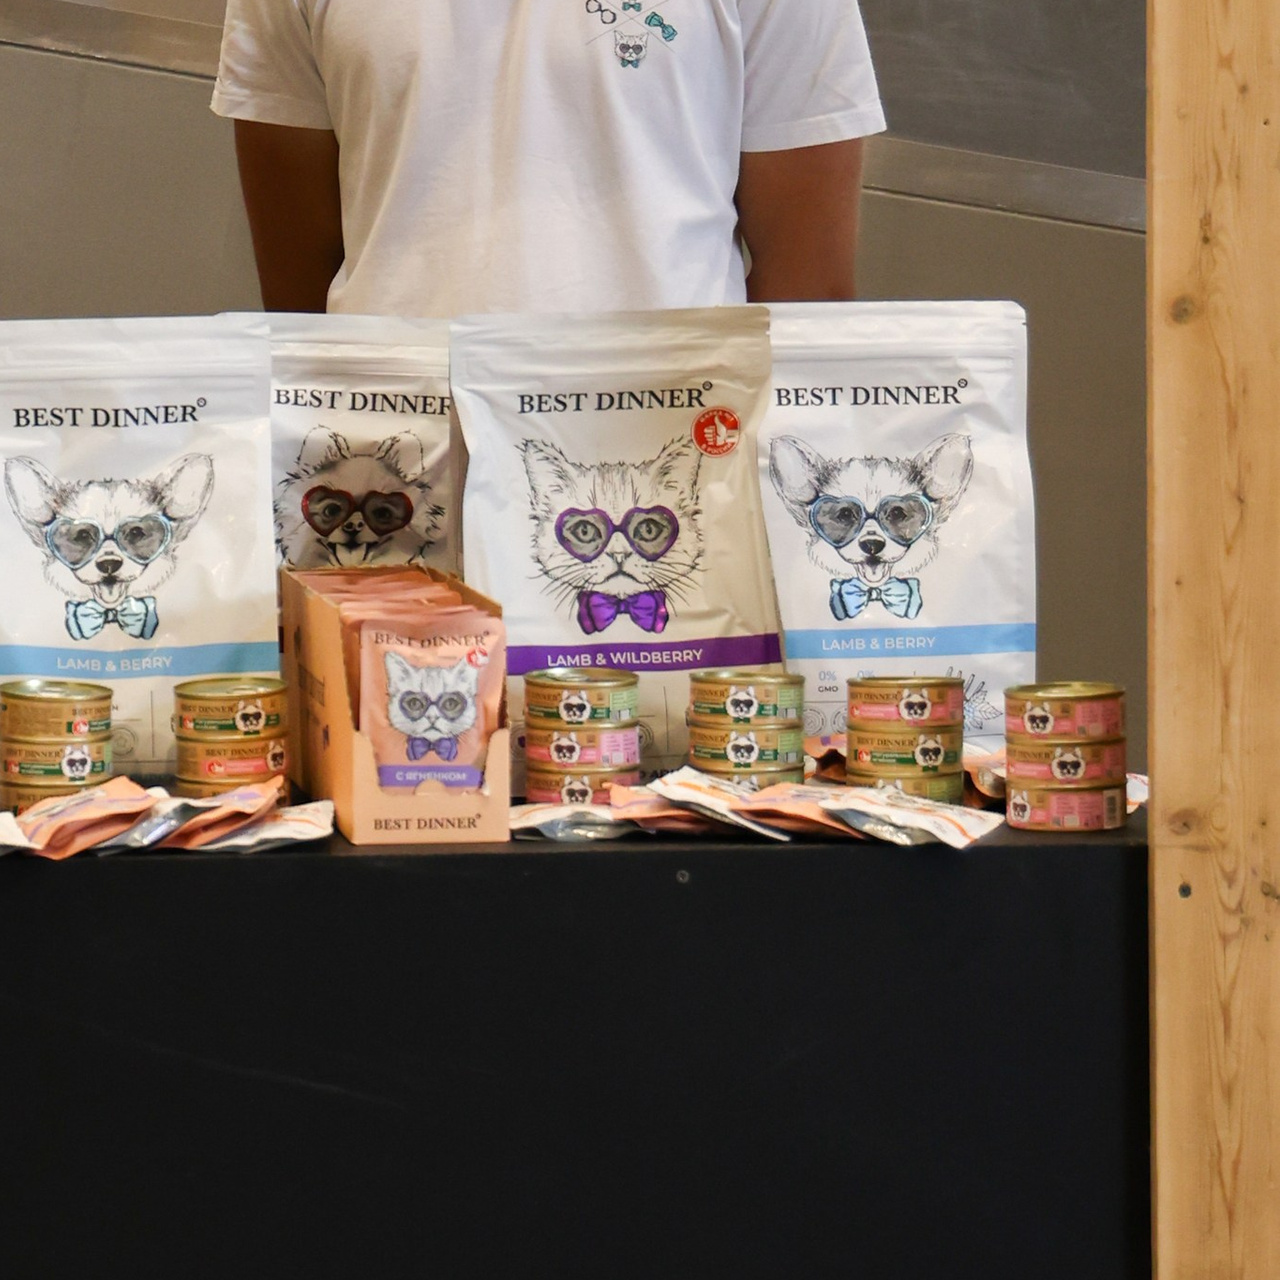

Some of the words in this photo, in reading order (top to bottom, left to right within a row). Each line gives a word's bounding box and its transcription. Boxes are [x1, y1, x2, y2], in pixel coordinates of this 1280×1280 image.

[274, 388, 343, 412] BEST
[518, 393, 587, 413] BEST
[595, 389, 705, 410] DINNER
[775, 387, 843, 408] BEST
[850, 385, 961, 406] DINNER
[13, 408, 83, 428] BEST
[91, 405, 198, 428] DINNER
[374, 632, 412, 646] BEST
[420, 634, 486, 648] DINNER
[822, 638, 866, 650] LAMB
[870, 639, 880, 650] &
[884, 637, 936, 649] BERRY
[57, 657, 101, 670] LAMB
[105, 660, 116, 671] &
[121, 656, 172, 669] BERRY
[547, 654, 591, 667] LAMB
[596, 654, 606, 665] &
[610, 649, 703, 664] WILDBERRY
[818, 670, 836, 682] 0%
[818, 685, 839, 693] GMO
[374, 819, 412, 830] BEST
[417, 818, 479, 830] DINNER
